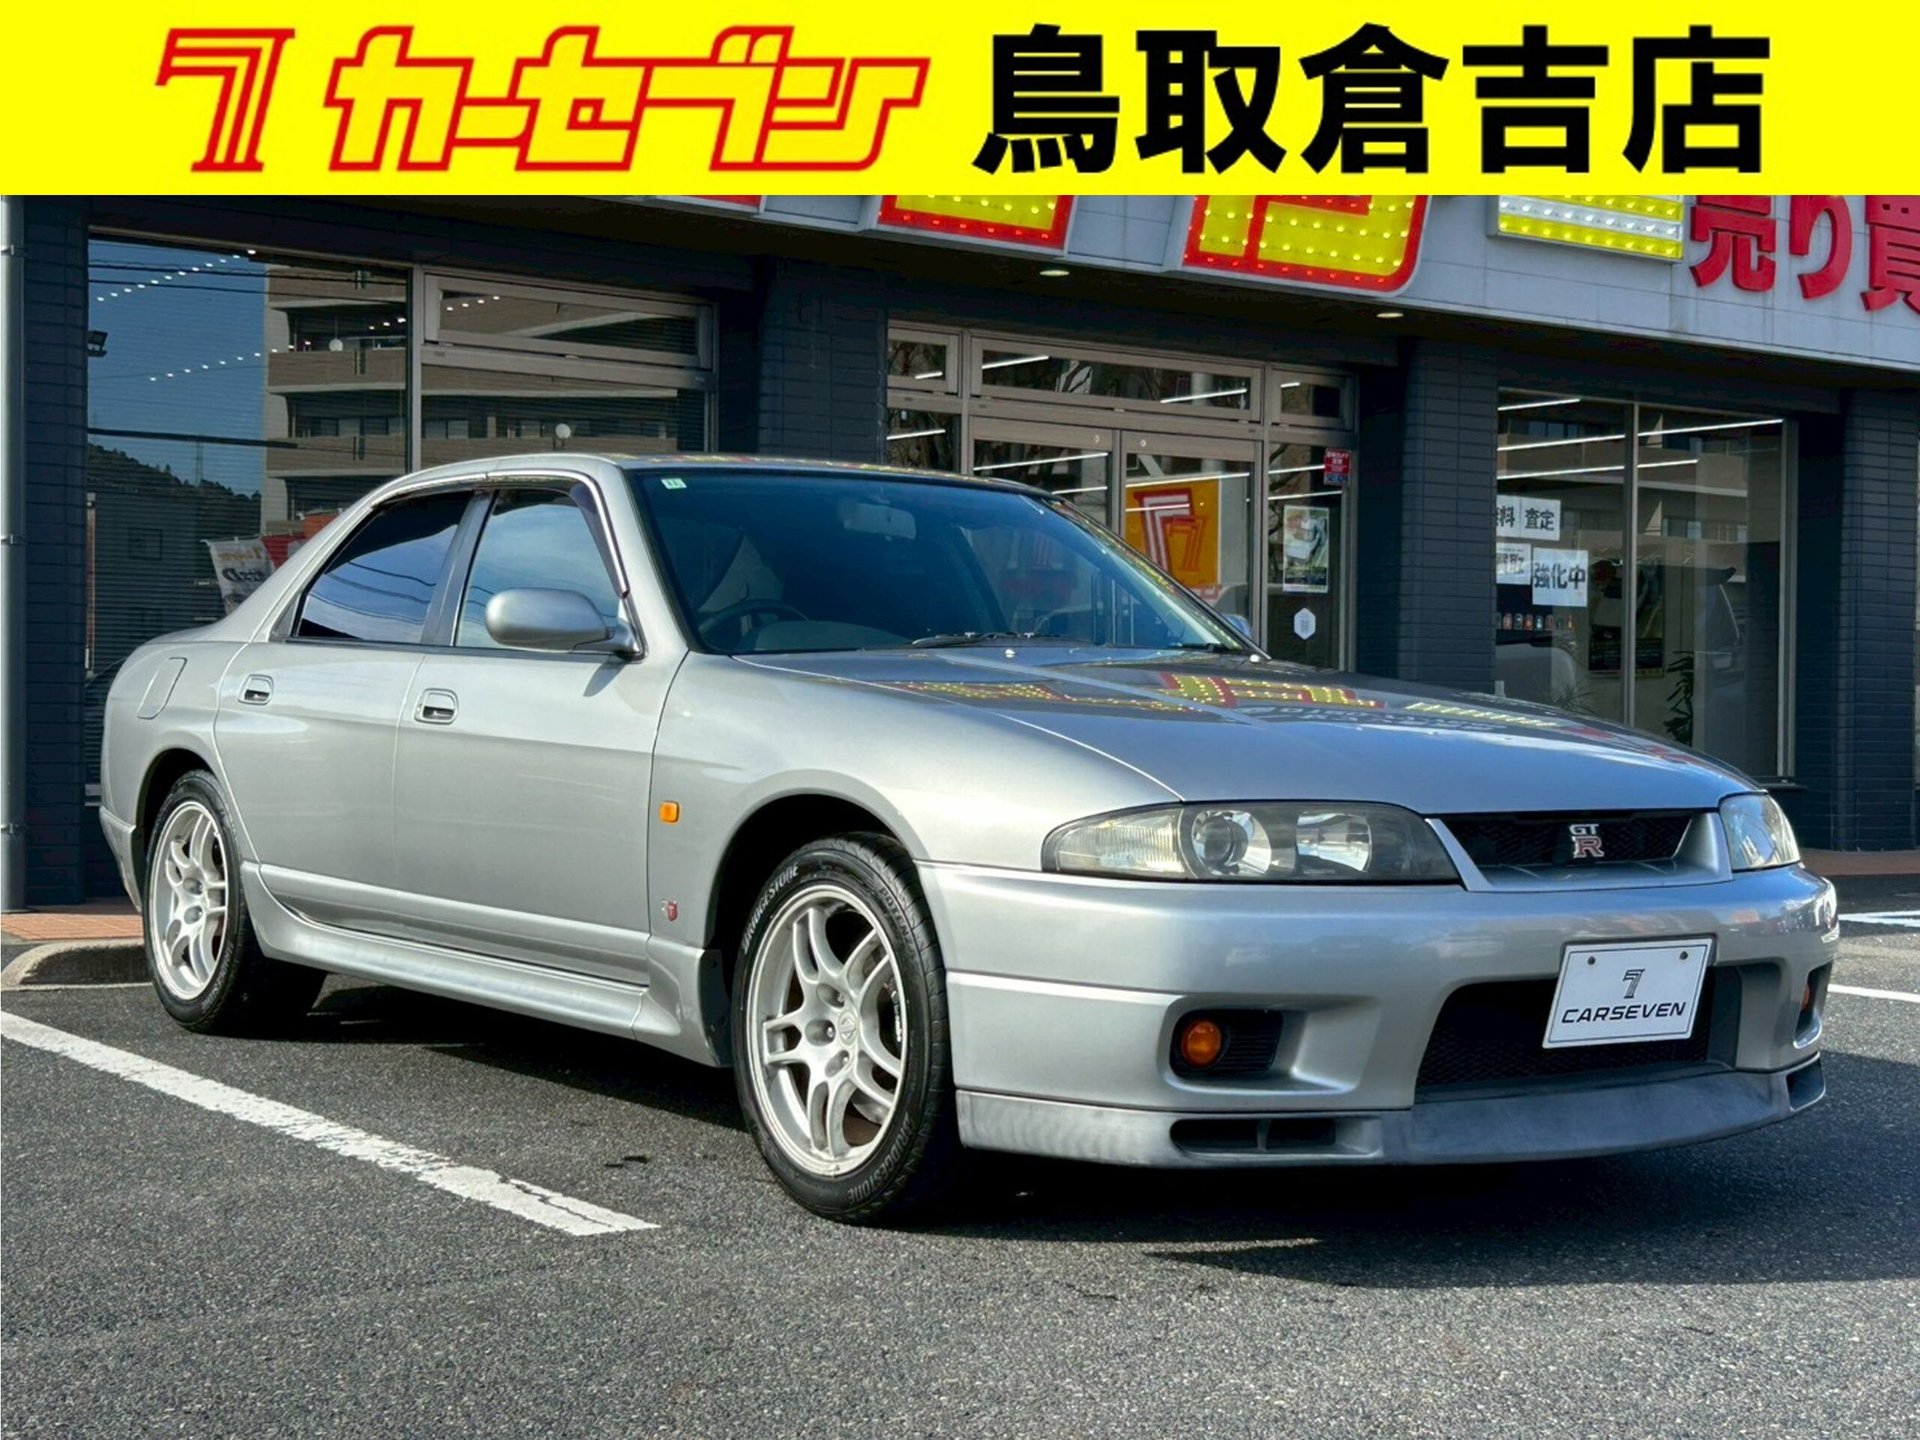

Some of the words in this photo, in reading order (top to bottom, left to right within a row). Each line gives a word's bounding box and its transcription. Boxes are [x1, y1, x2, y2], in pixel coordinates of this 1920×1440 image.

[1524, 508, 1555, 531] 査定
[1534, 563, 1585, 589] 強化中
[1569, 823, 1599, 835] GT
[1572, 835, 1605, 859] R
[741, 861, 799, 954] BRIDGESTONE
[1561, 1002, 1687, 1024] CARSEVEN
